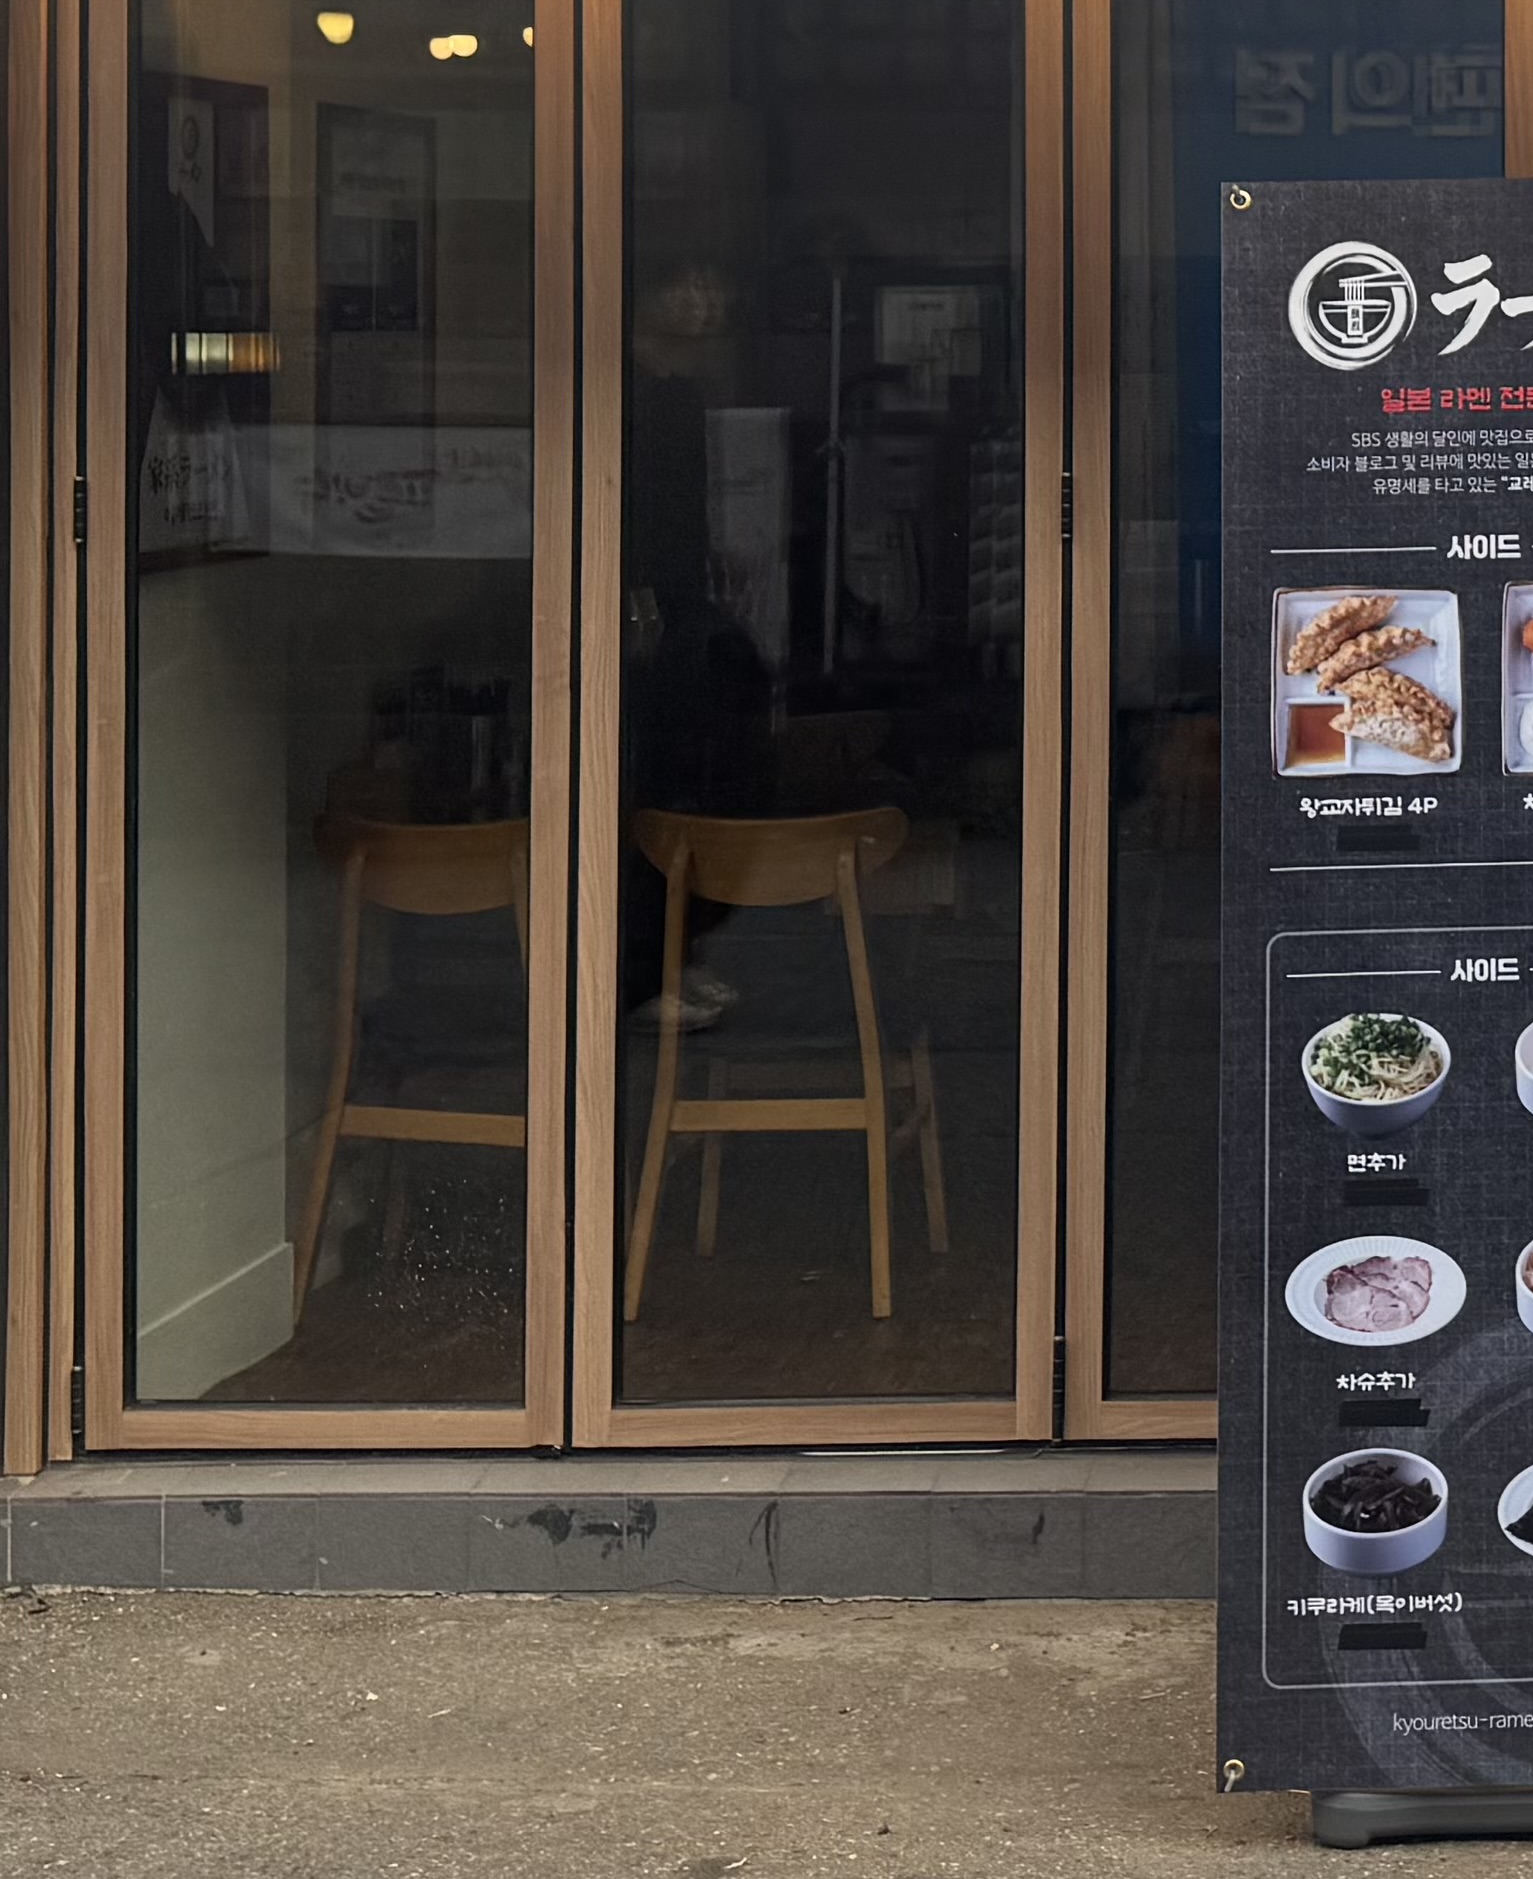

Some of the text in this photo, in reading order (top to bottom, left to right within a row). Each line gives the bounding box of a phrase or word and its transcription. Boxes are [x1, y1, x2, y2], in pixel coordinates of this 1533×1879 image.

[1381, 387, 1432, 413] 일본
[1439, 386, 1491, 412] 라멘
[1351, 432, 1381, 447] SBS
[1385, 431, 1429, 447] 생활의
[1432, 430, 1476, 446] 달인에
[1307, 455, 1350, 473] 소비자
[1354, 455, 1398, 472] 블로그
[1420, 453, 1463, 470] 리뷰에
[1467, 453, 1512, 470] 맛있는
[1372, 478, 1430, 495] 유명세를
[1435, 477, 1464, 494] 타고
[1468, 476, 1496, 493] 있는
[1447, 533, 1521, 560] 사이드
[1299, 796, 1438, 818] 왕교자튀김 4P
[1450, 957, 1521, 983] 사이드
[1347, 1153, 1407, 1173] 면추가
[1336, 1372, 1416, 1392] 차슈추가
